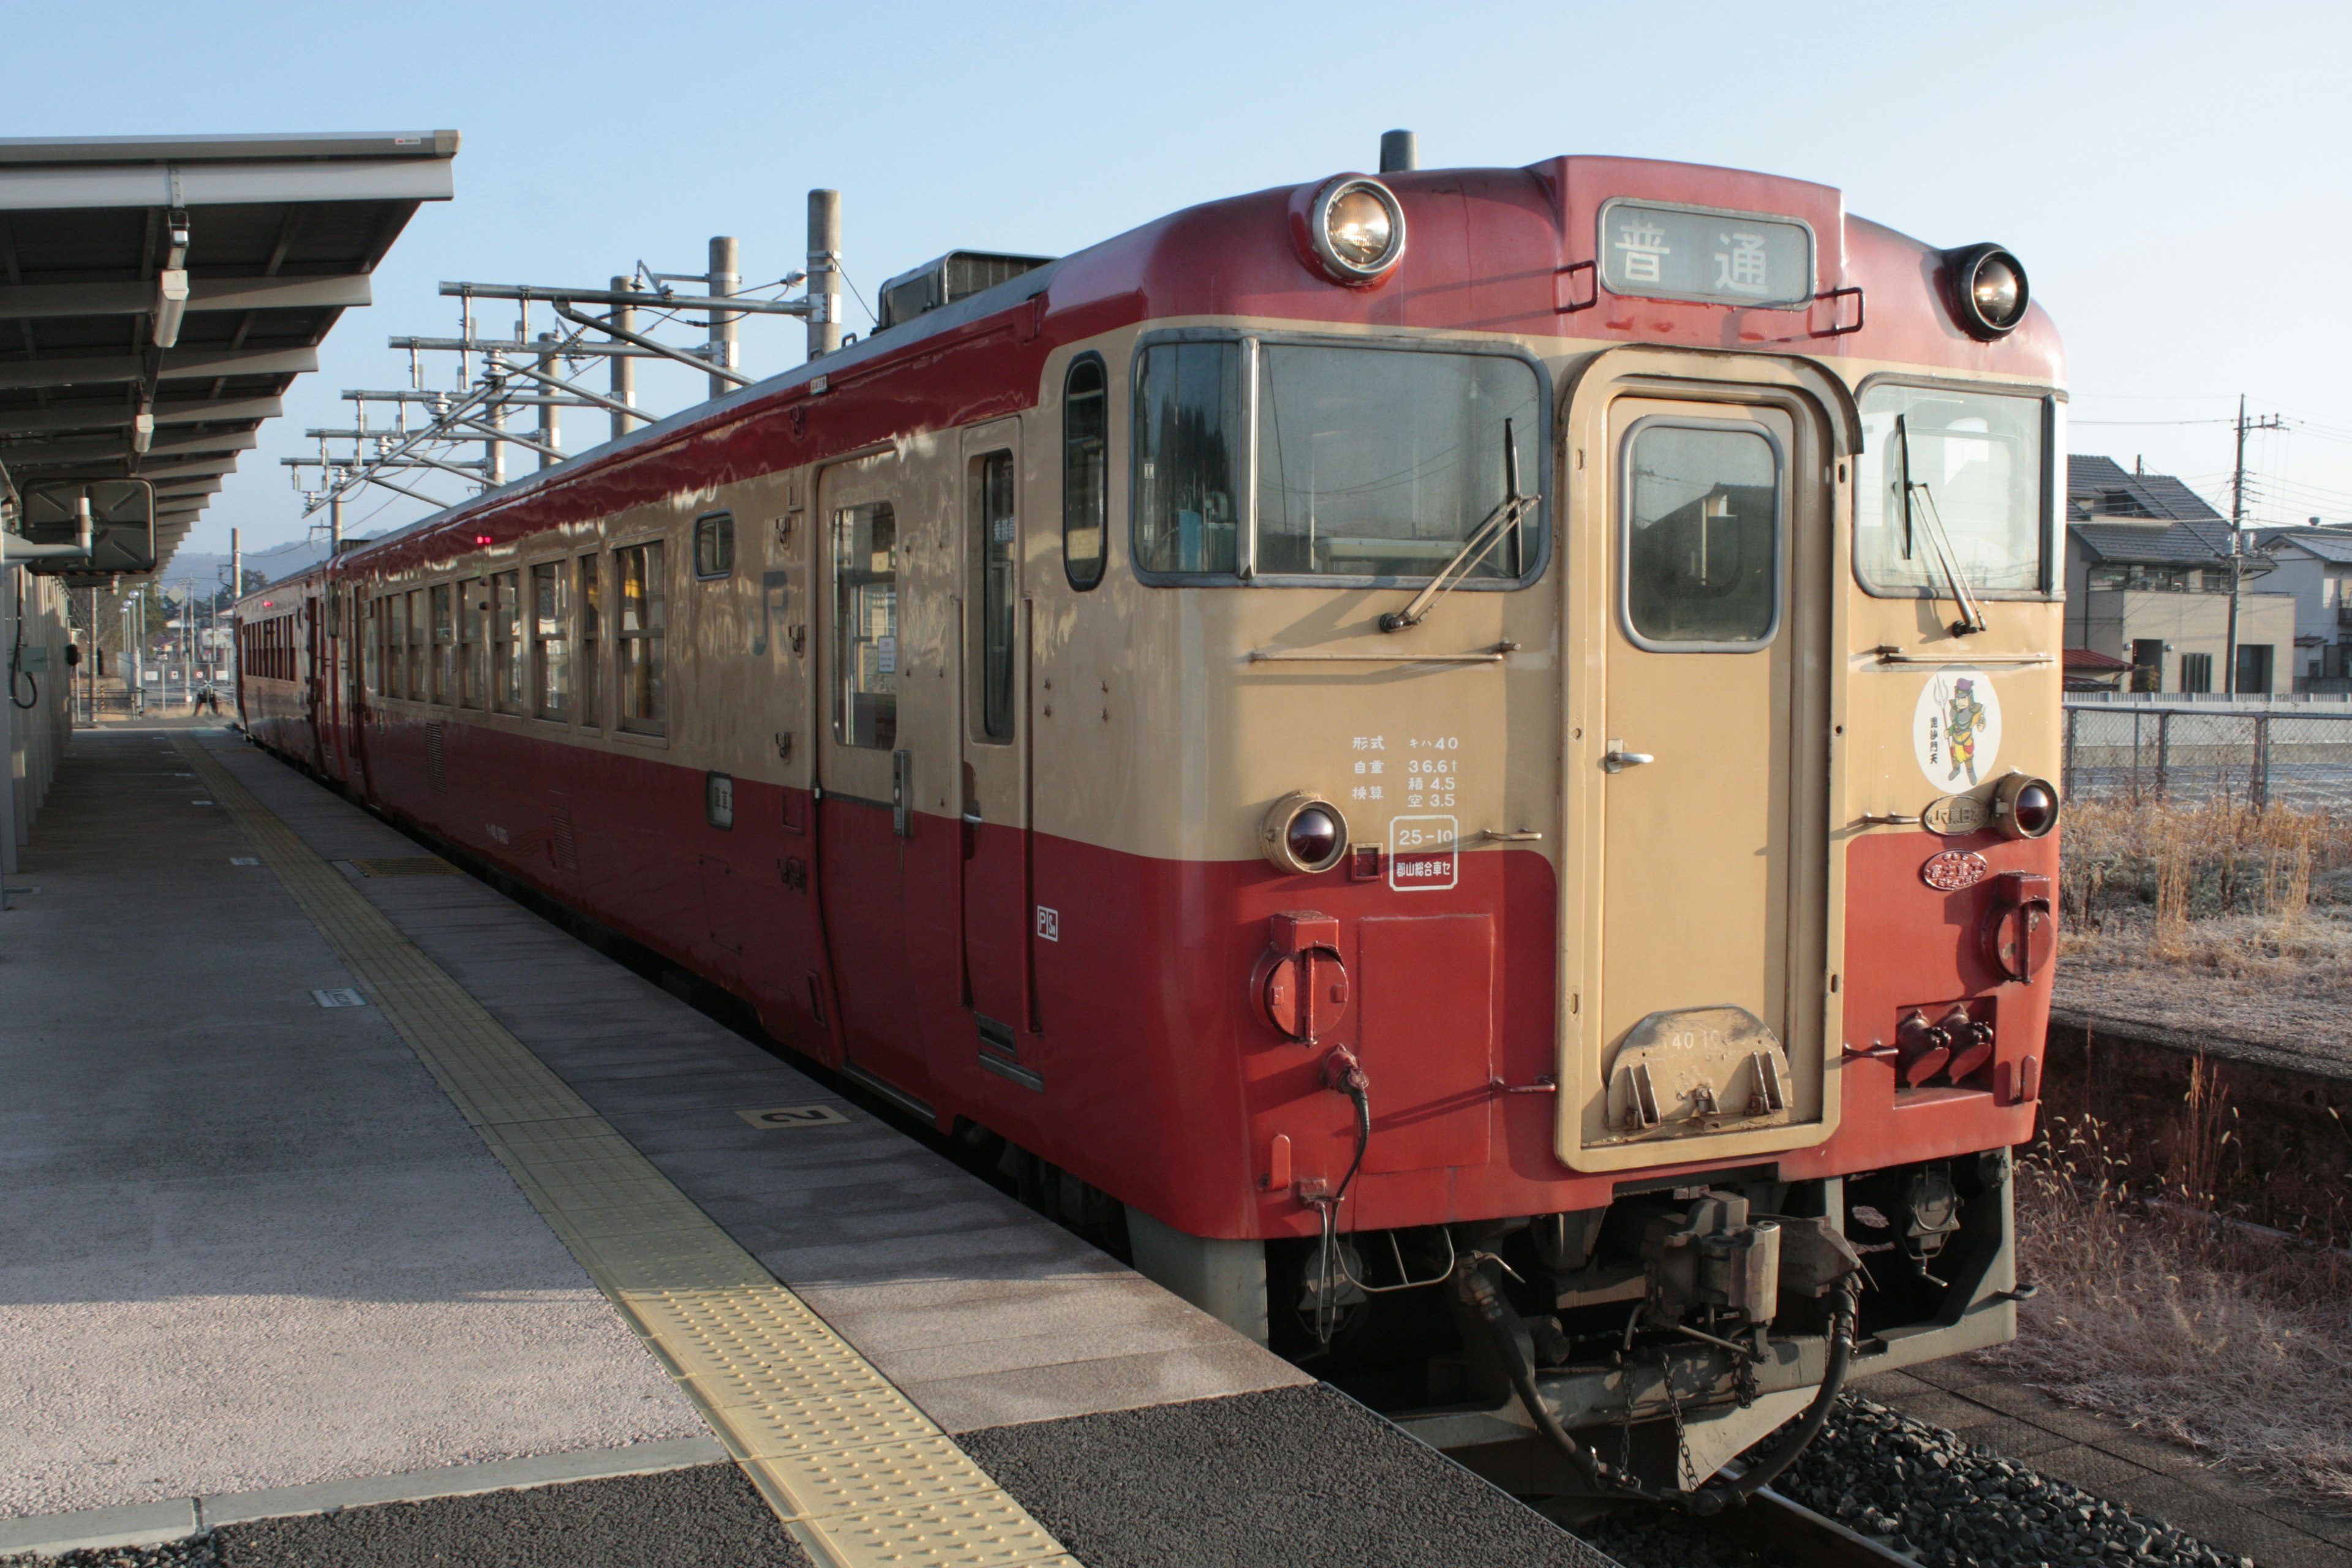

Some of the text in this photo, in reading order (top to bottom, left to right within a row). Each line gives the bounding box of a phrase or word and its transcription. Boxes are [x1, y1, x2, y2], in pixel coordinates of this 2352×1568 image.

[1615, 219, 1770, 294] 普通
[748, 570, 788, 655] JR
[1352, 736, 1458, 750] 形式 キハ40
[1354, 760, 1384, 774] 自重
[1408, 777, 1455, 791] 積 4.5
[1352, 785, 1384, 800] 換算
[1408, 794, 1455, 807] 空 3.5
[1931, 807, 1981, 825] JR東日本
[1398, 829, 1453, 845] 25-10
[1396, 861, 1451, 877] 郡山総合車セ
[760, 1110, 829, 1123] 2
